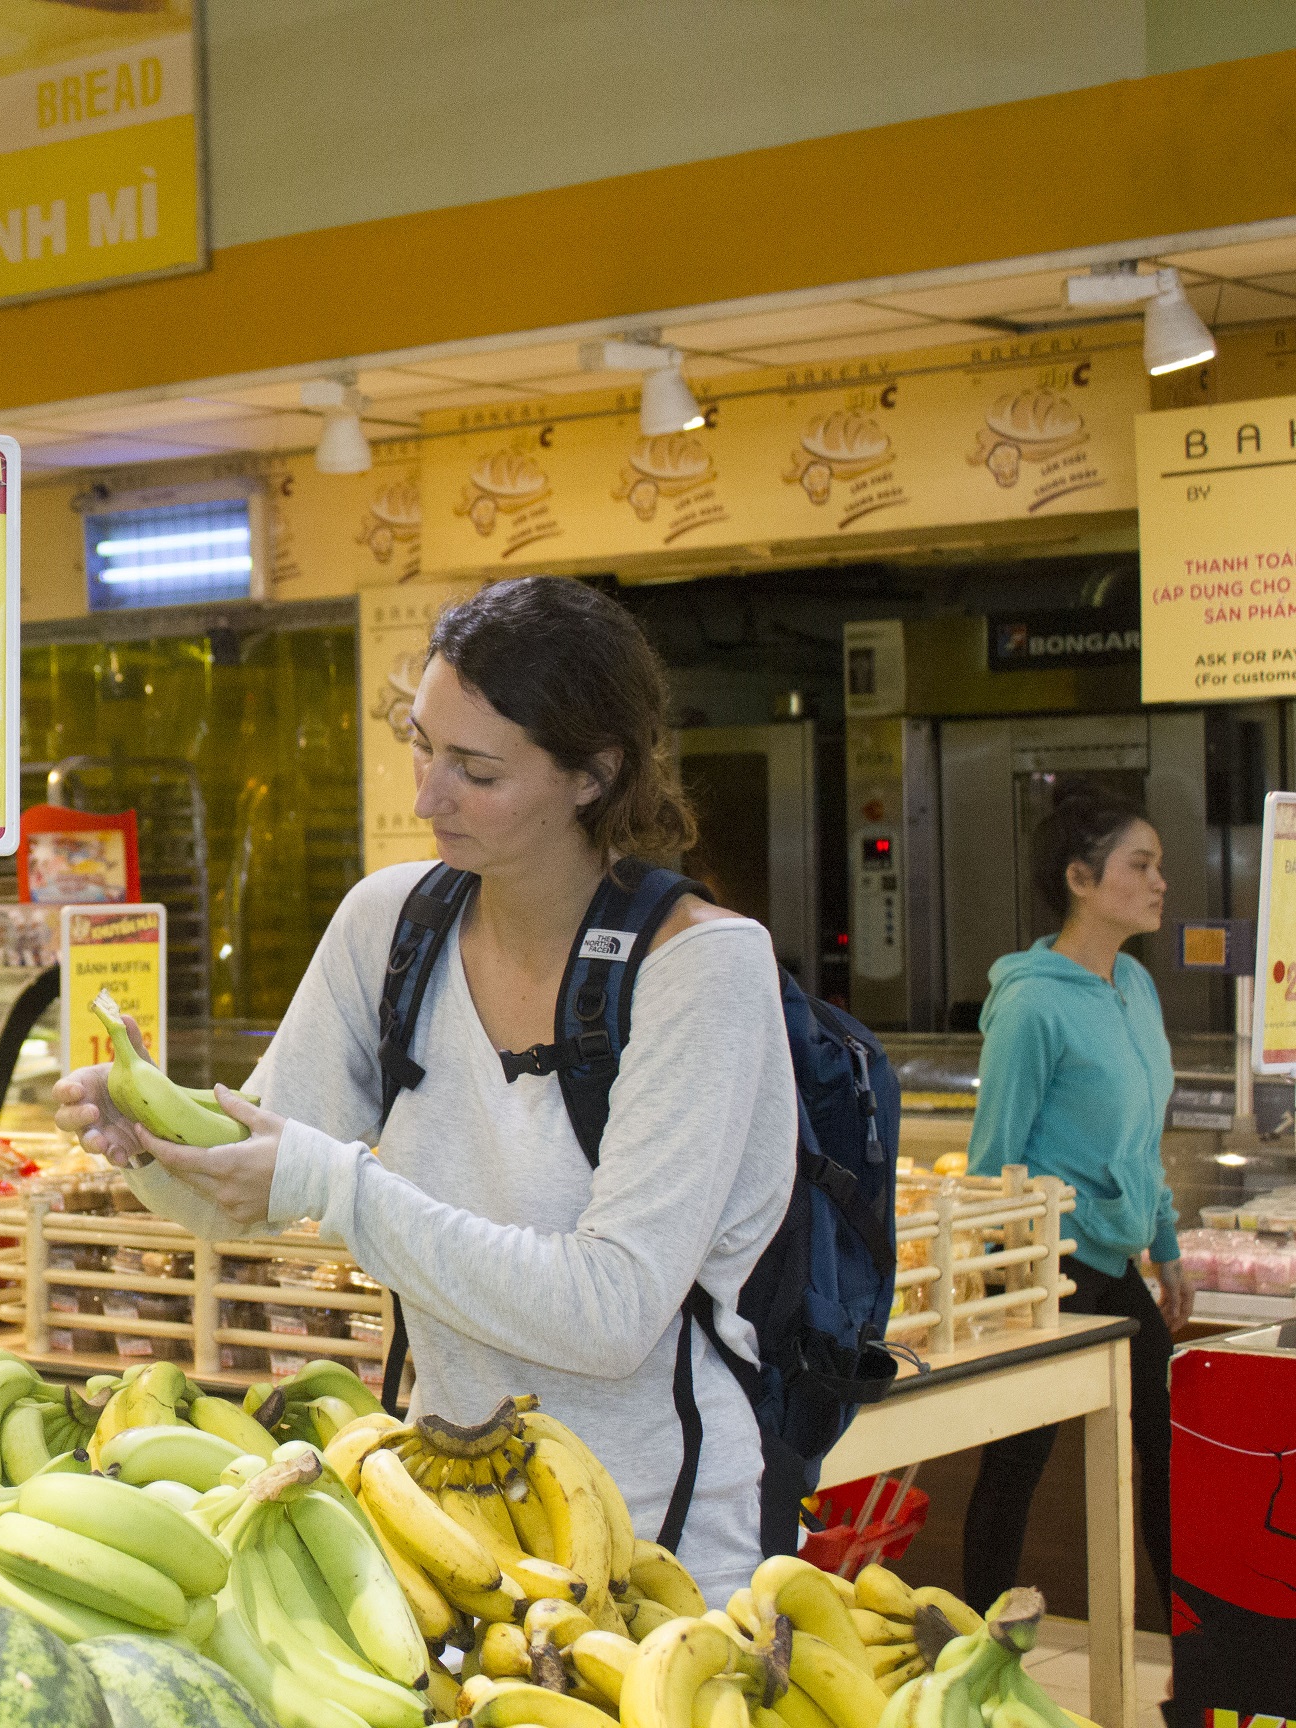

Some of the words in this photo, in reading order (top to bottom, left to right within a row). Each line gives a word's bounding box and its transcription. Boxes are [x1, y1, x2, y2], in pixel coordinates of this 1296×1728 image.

[37, 57, 163, 130] BREAD
[88, 167, 159, 248] MÌ
[1187, 485, 1212, 502] BY
[1184, 555, 1249, 575] THANH
[1255, 548, 1296, 571] TOÁ
[1190, 580, 1244, 602] DỤNG
[1250, 576, 1291, 596] CHO
[1195, 652, 1227, 668] ASK
[1232, 650, 1267, 665] FOR
[1194, 671, 1228, 688] (For
[588, 945, 609, 953] FACE
